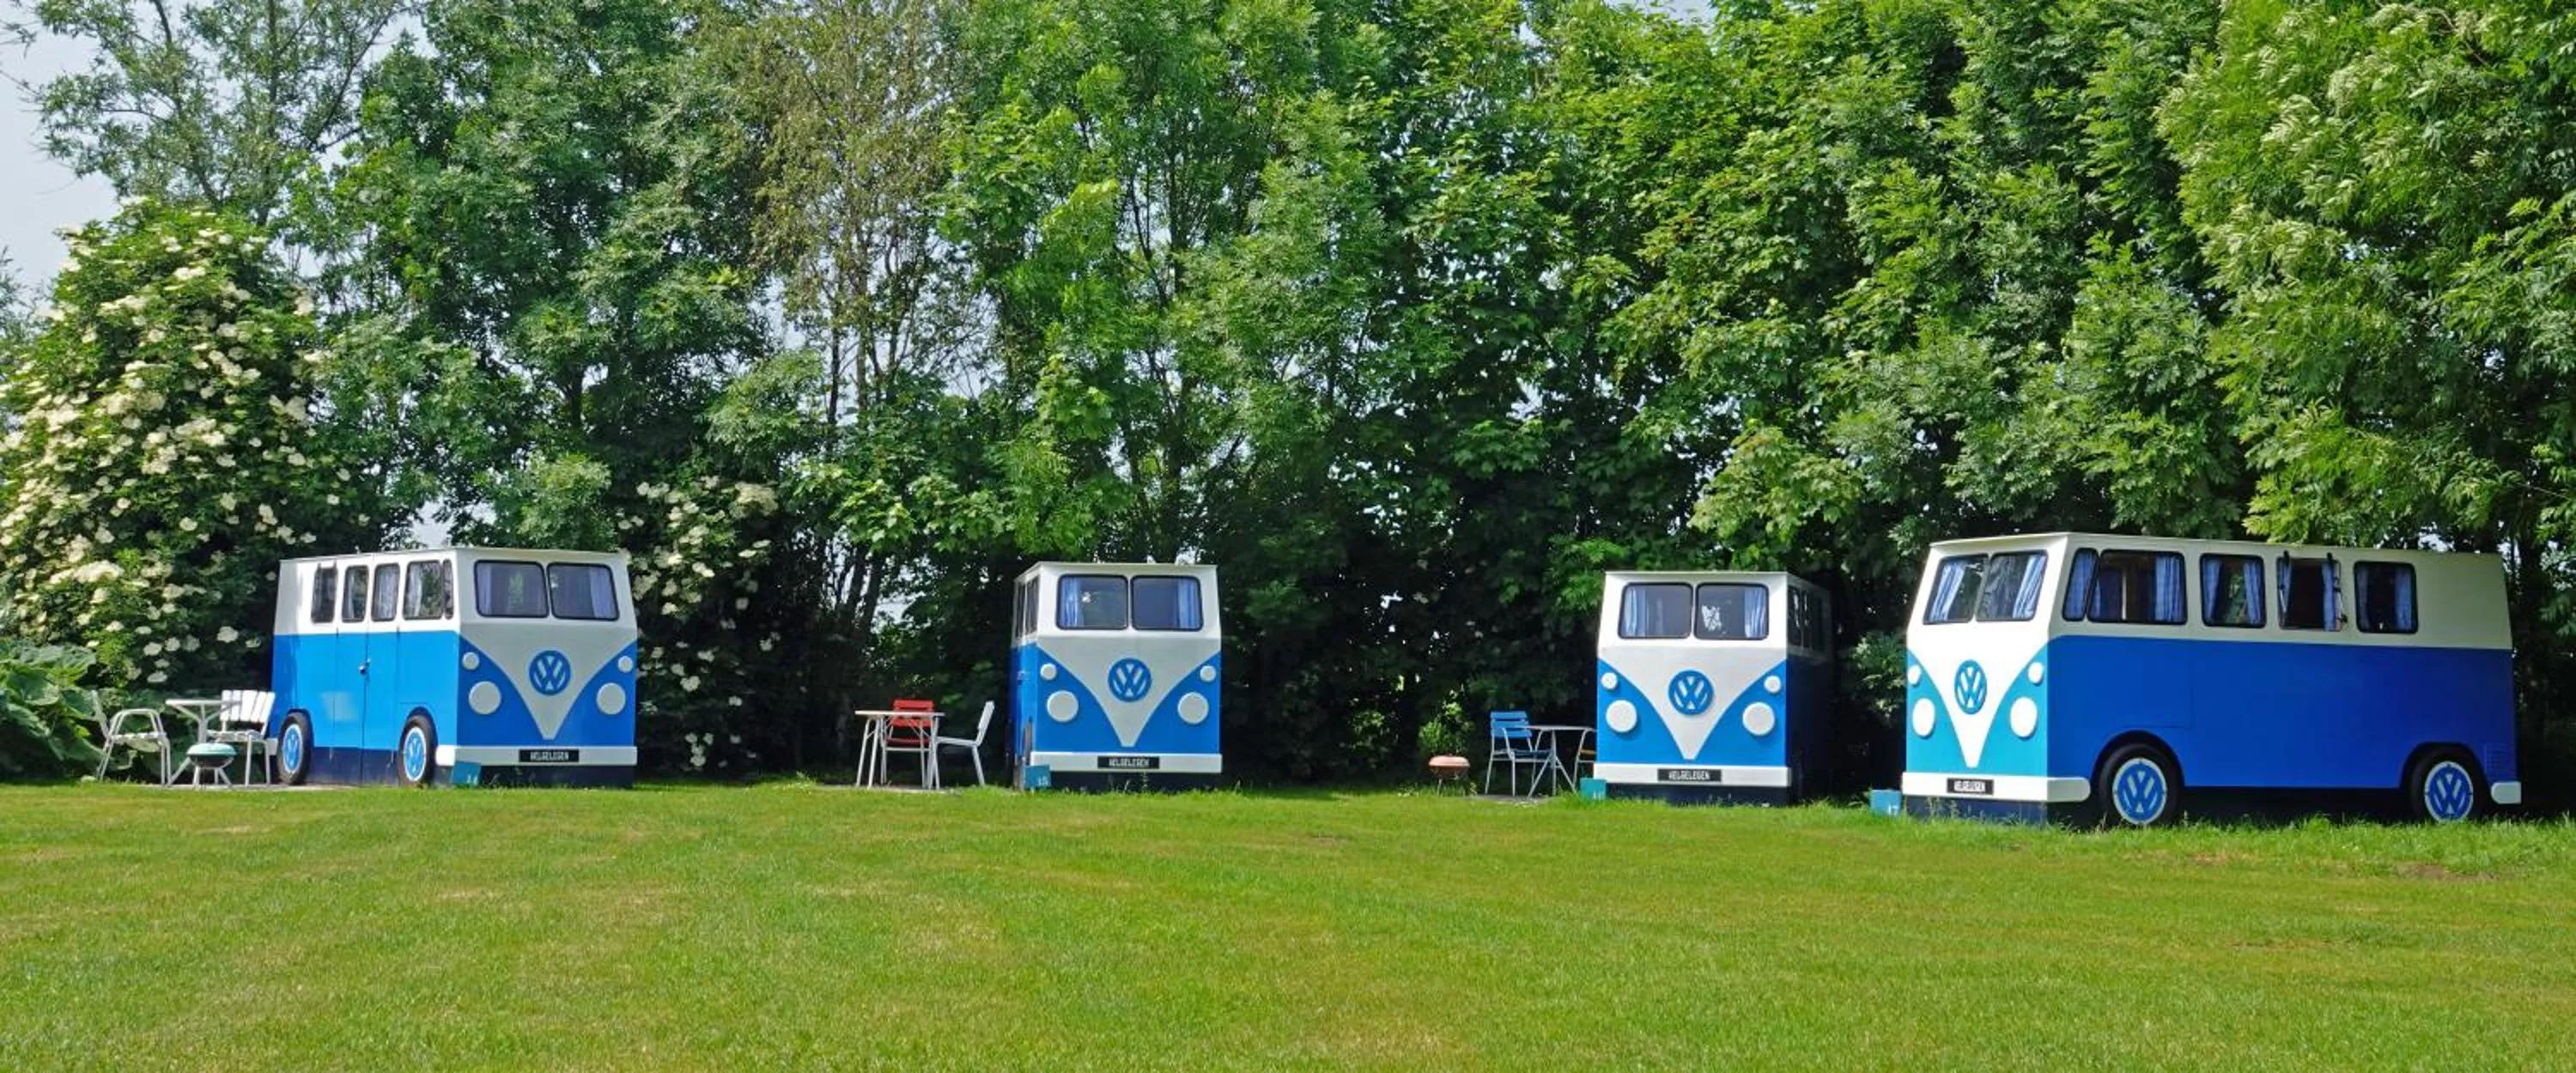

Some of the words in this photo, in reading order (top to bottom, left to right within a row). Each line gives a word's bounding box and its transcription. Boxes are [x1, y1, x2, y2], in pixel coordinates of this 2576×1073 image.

[529, 651, 571, 695] VW
[1109, 658, 1151, 702] VW
[1669, 670, 1714, 714] VW
[1954, 659, 1987, 714] VW
[2117, 763, 2163, 821] VW
[2429, 767, 2470, 819] VW
